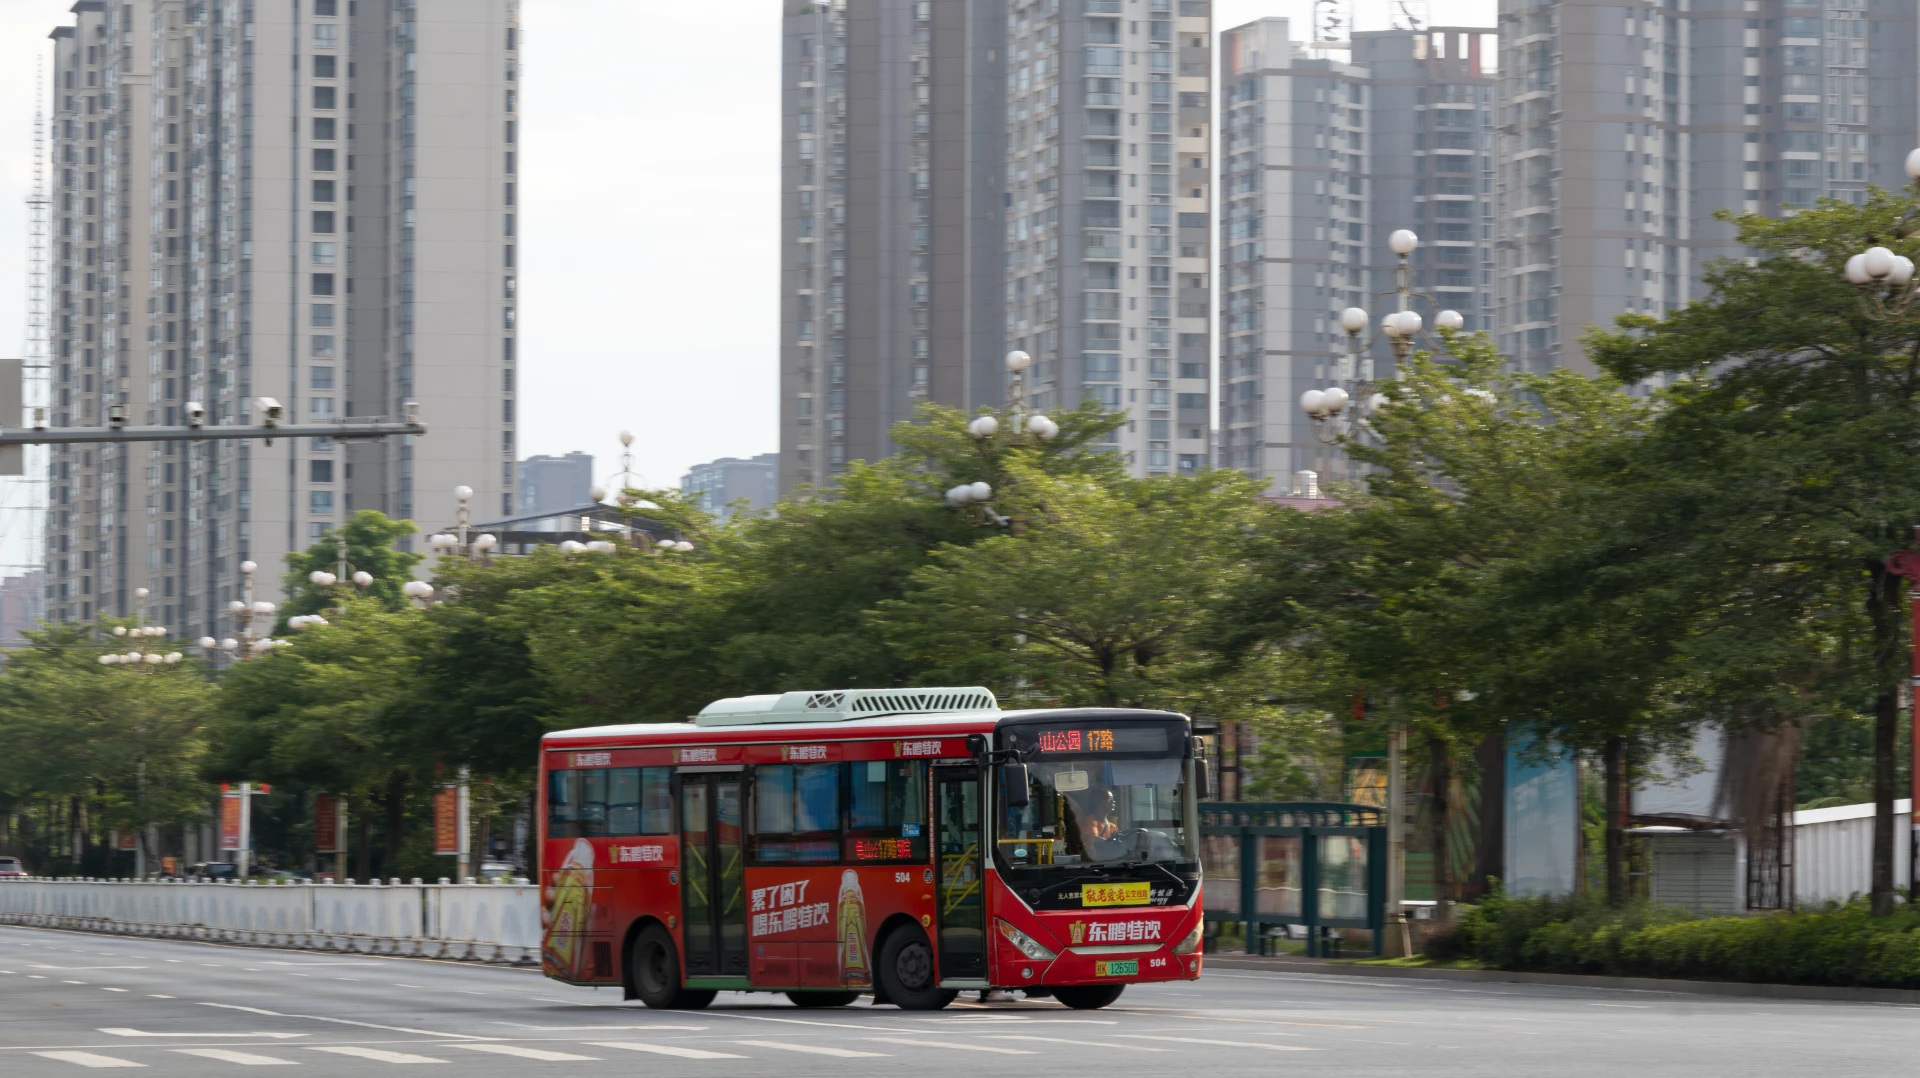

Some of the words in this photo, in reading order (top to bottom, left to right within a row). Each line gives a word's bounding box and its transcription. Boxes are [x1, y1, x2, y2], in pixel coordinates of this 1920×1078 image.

[902, 740, 942, 756] 东鹏特饮
[1087, 729, 1114, 751] 17路
[576, 752, 612, 767] 东鹏特饮
[680, 748, 718, 763] 东鹏特饮
[789, 745, 827, 760] 东鹏特饮
[619, 845, 664, 862] 东鹏特饮
[895, 872, 911, 883] 504
[751, 879, 810, 912] 累了困了
[752, 902, 830, 937] 喝东鹏特饮
[1088, 920, 1161, 942] 东鹏特饮
[1150, 958, 1166, 967] 504
